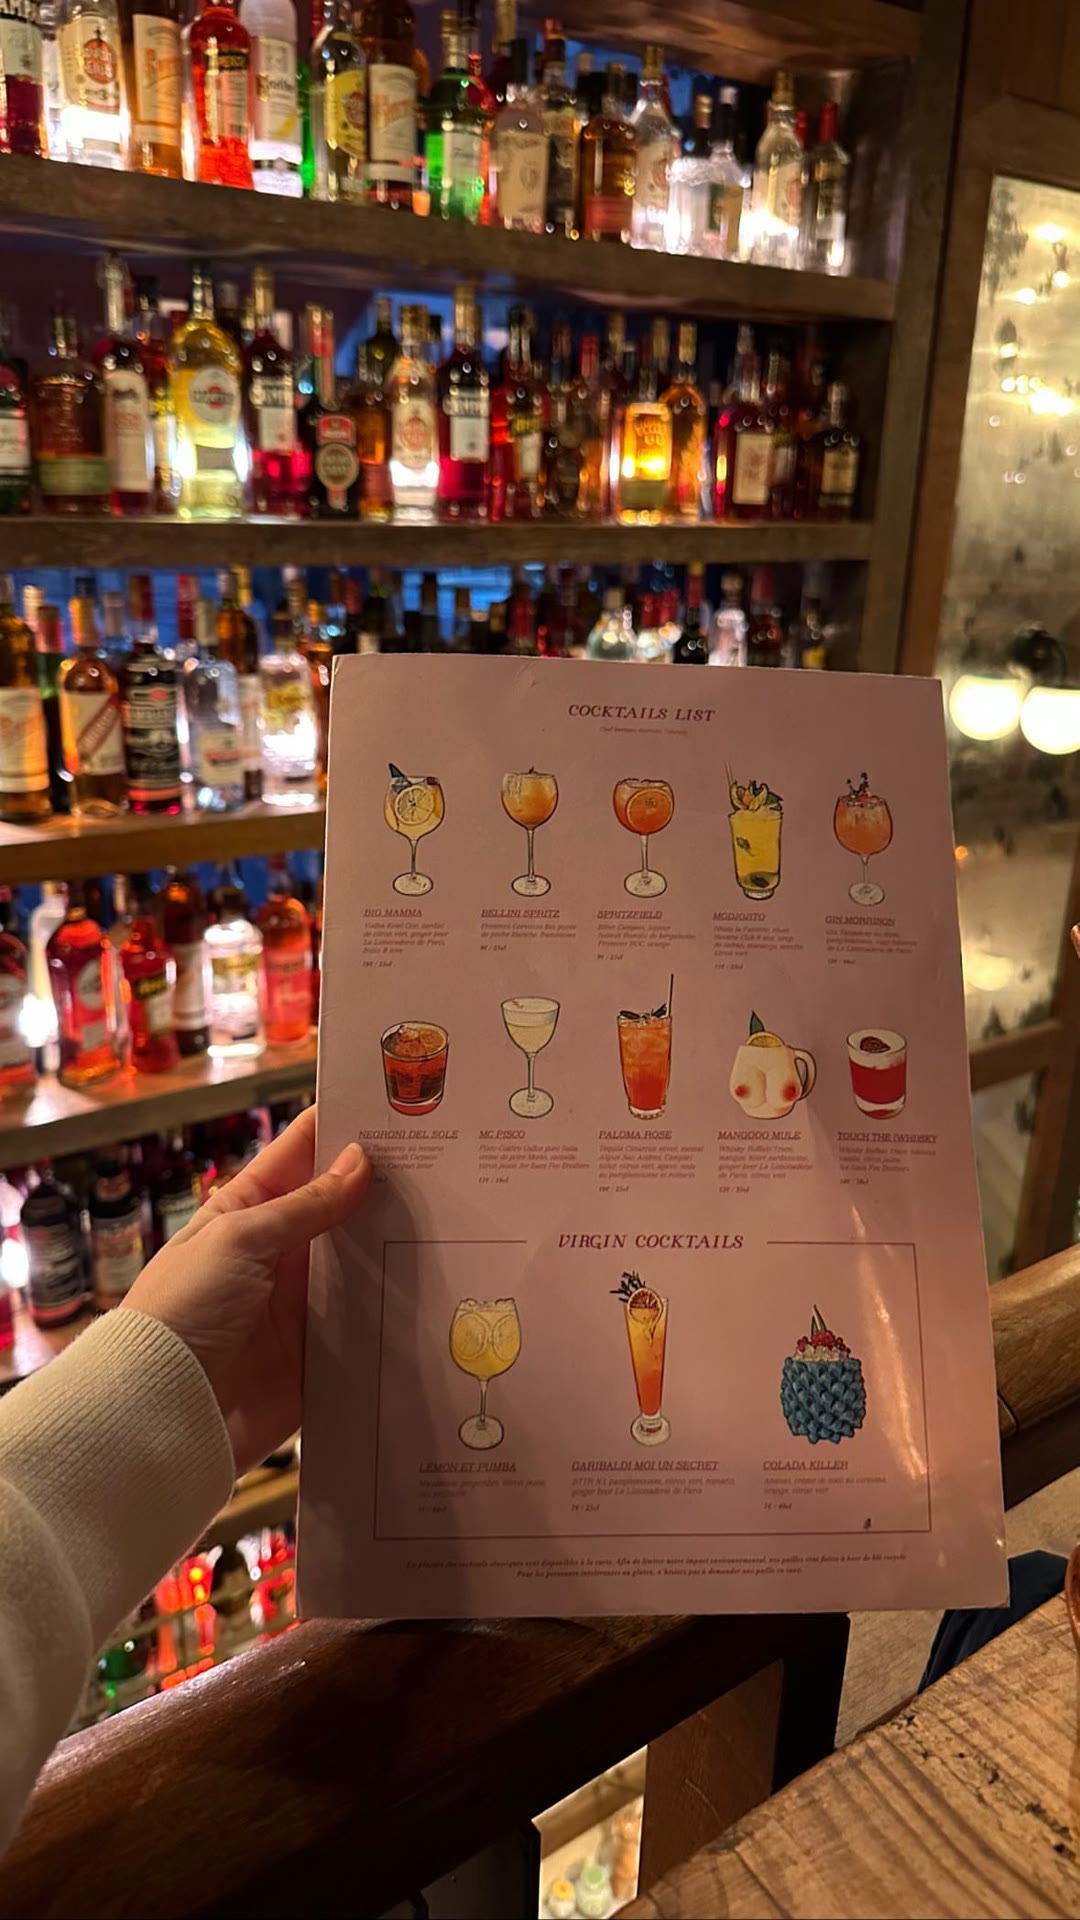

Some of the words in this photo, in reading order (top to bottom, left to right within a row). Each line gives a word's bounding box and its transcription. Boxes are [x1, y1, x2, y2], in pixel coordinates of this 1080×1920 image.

[568, 704, 667, 720] COCKTAILS
[675, 708, 715, 721] LIST
[385, 908, 422, 917] MAMMA
[481, 909, 521, 918] BELLINI
[523, 909, 560, 918] SPRITZ
[597, 910, 663, 919] SPRITZFIELD
[825, 915, 842, 924] GIN
[843, 917, 895, 926] MORRISON
[358, 1130, 405, 1139] NEGRONI
[408, 1130, 428, 1139] DEL
[432, 1130, 458, 1139] SOLE
[479, 1130, 493, 1139] MC
[497, 1130, 525, 1139] PISCO
[599, 1130, 641, 1139] PALOMA
[645, 1130, 672, 1139] ROSE
[772, 1131, 801, 1140] MULE
[838, 1132, 869, 1142] TOUCH
[871, 1133, 891, 1142] THE
[558, 1235, 626, 1250] VIRGIN
[635, 1235, 744, 1249] COCKTAILS
[419, 1462, 457, 1473] LEMON
[460, 1463, 474, 1473] ET
[477, 1462, 516, 1472] PUMBA
[572, 1461, 631, 1472] GARIBALDI
[635, 1462, 654, 1471] MOI
[658, 1461, 673, 1471] UN
[676, 1461, 718, 1471] SECRET
[763, 1461, 806, 1471] COLADA
[809, 1461, 848, 1470] KILLER
